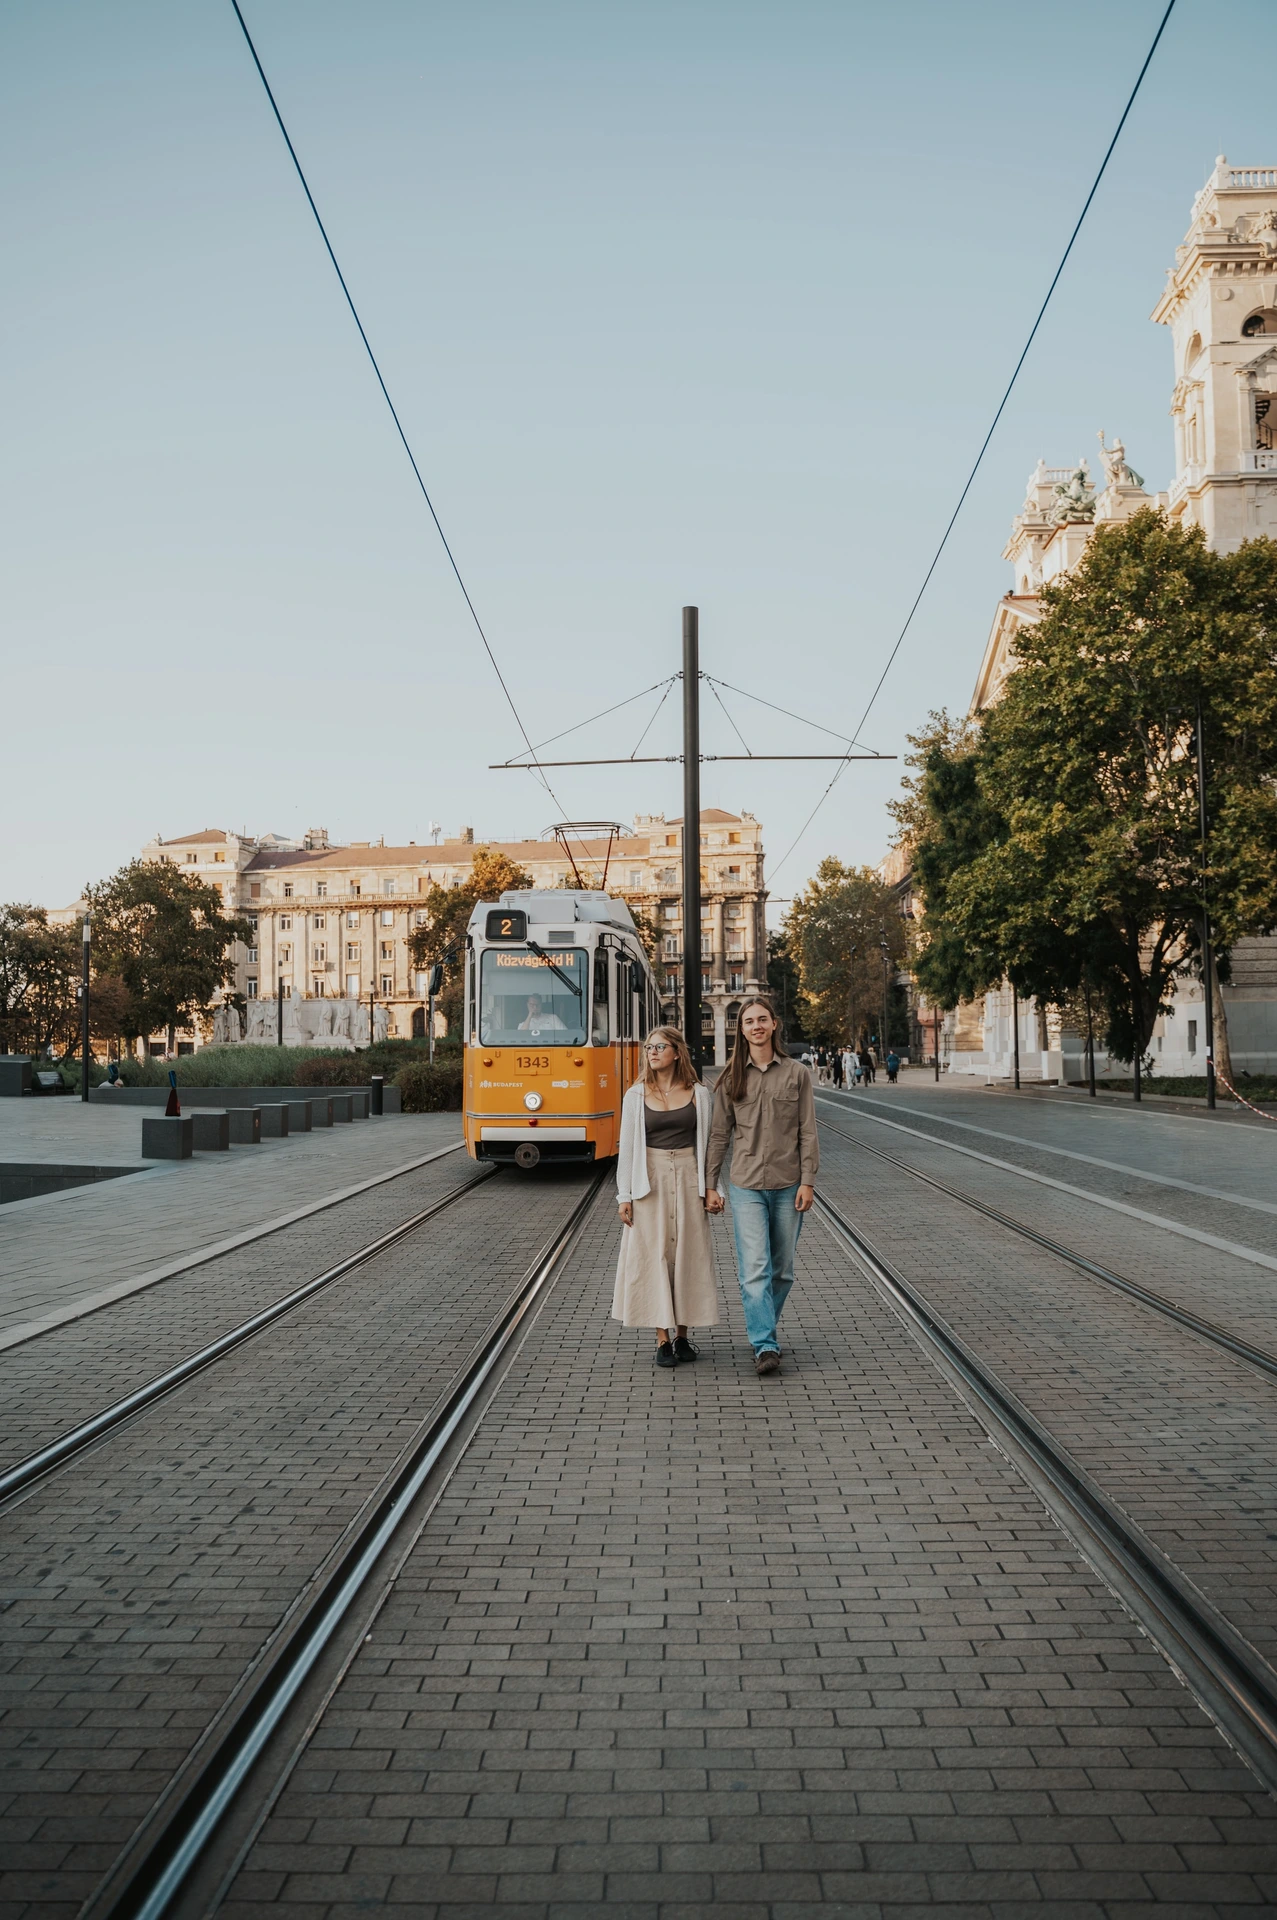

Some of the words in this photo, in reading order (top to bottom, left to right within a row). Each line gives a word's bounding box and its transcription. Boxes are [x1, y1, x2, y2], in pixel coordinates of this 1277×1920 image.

[501, 918, 512, 935] 2
[565, 953, 574, 967] H
[516, 1056, 549, 1068] 1343
